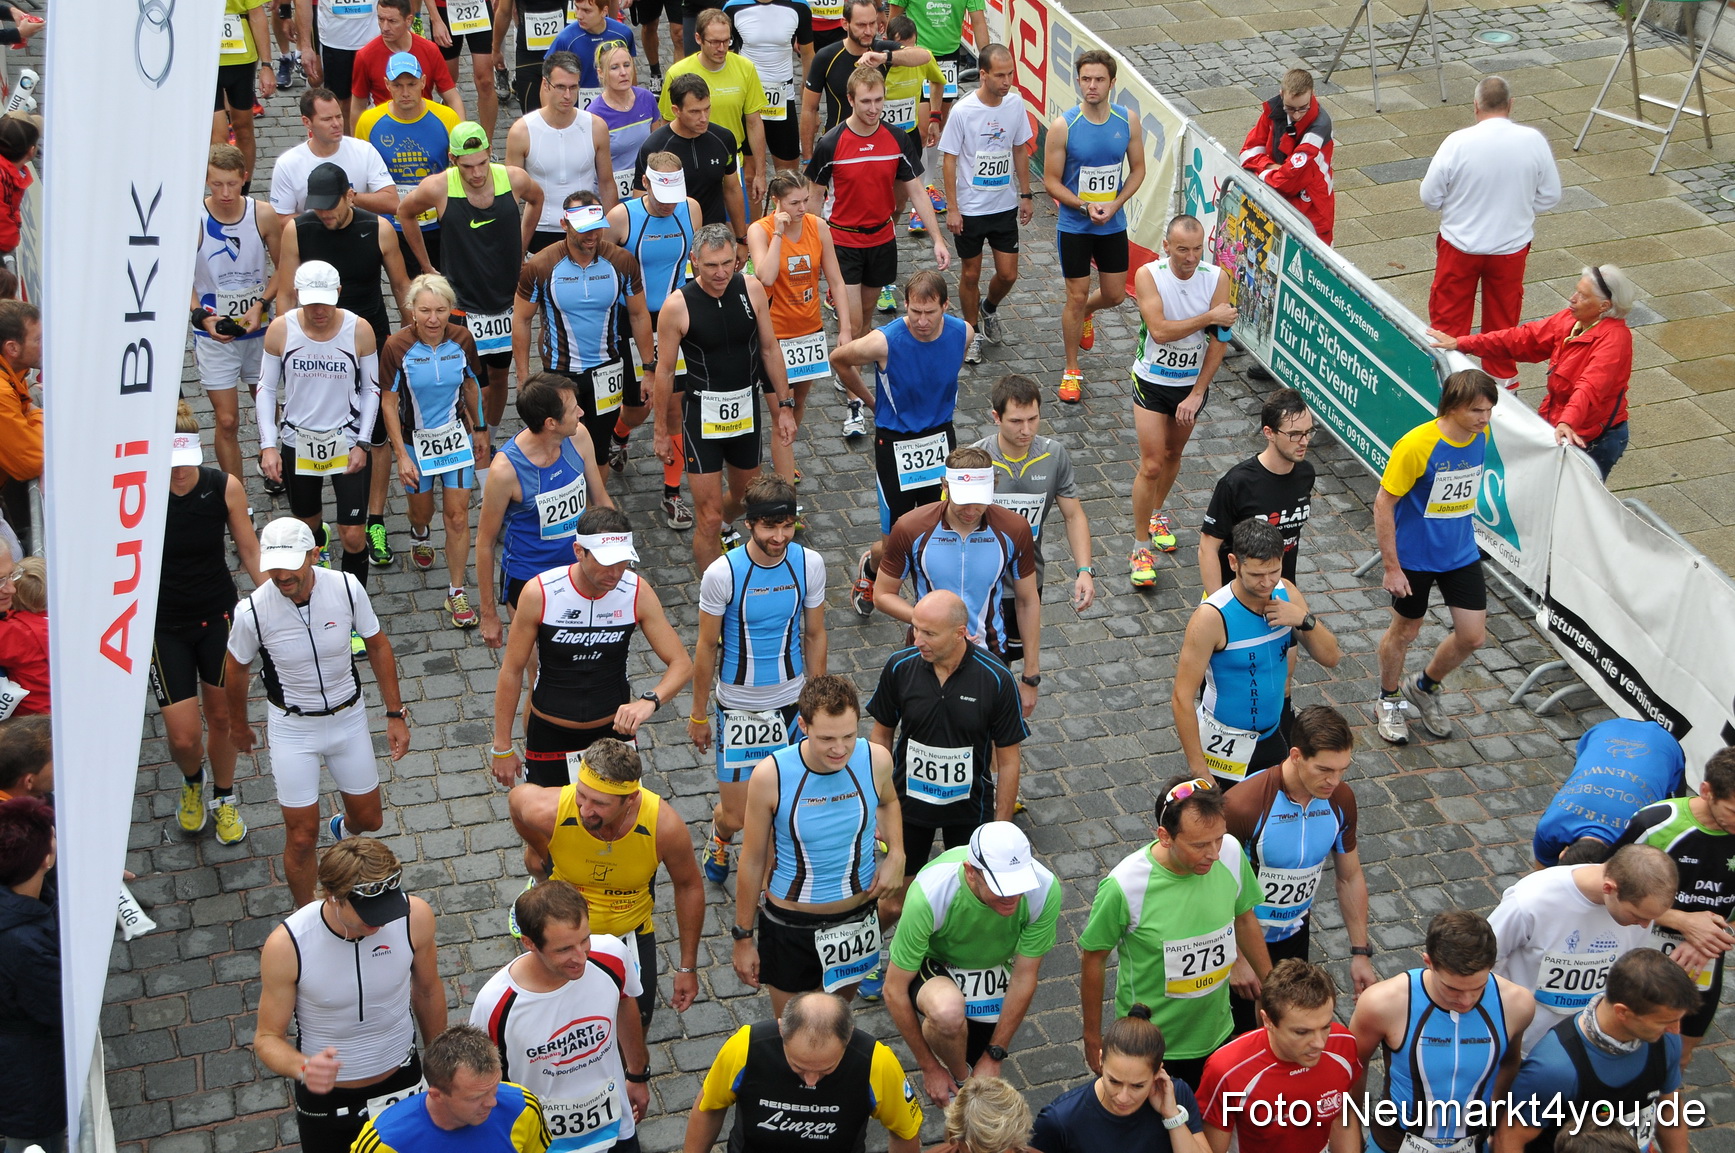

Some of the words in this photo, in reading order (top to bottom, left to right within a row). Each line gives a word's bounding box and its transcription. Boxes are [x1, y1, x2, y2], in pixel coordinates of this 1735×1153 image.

[456, 5, 480, 21] 232
[221, 23, 232, 38] 8
[462, 21, 478, 30] Franz
[534, 21, 558, 37] 622
[978, 159, 1009, 176] 2500
[983, 177, 1004, 186] Michael
[1088, 174, 1115, 192] 619
[120, 180, 163, 395] BKK
[236, 289, 258, 299] Neumarkt
[1307, 269, 1380, 343] Event-Leit-Systeme
[473, 316, 512, 338] 3400
[1282, 292, 1317, 331] Mehr
[1317, 323, 1379, 394] Sicherheit
[307, 353, 334, 361] TEAM
[786, 344, 824, 366] 3375
[1156, 348, 1198, 369] 2894
[1279, 320, 1297, 348] für
[1299, 334, 1318, 367] Ihr
[1318, 356, 1359, 403] Event!
[292, 358, 348, 374] ERDINGER
[794, 364, 815, 375] HAIKE
[1160, 368, 1189, 379] Berthold
[293, 372, 348, 381] ALKOHOLFREI
[703, 394, 721, 402] PARTL
[722, 393, 745, 402] Neumarkt
[719, 402, 739, 421] 68
[1276, 357, 1293, 380] Miet
[1293, 374, 1300, 388] &
[1301, 381, 1327, 418] Service
[1328, 405, 1346, 434] Line:
[1346, 425, 1371, 455] 09181
[1371, 447, 1391, 475] 635
[714, 422, 742, 432] Manfred
[306, 440, 338, 461] 187
[420, 432, 465, 458] 2642
[914, 439, 939, 450] Neumarkt
[313, 460, 334, 470] Klaus
[433, 454, 460, 468] Marion
[901, 445, 945, 471] 3324
[538, 494, 560, 506] PARTL
[559, 484, 580, 499] Neumarkt
[1441, 480, 1473, 501] 245
[546, 490, 585, 525] 2200
[1437, 503, 1469, 513] Johannes
[1473, 521, 1498, 549] Service
[1498, 545, 1521, 569] GmbH
[100, 440, 150, 676] Audi
[551, 629, 624, 647] Energizer
[1600, 657, 1618, 679] die
[1620, 673, 1673, 732] verbinden
[730, 721, 783, 746] 2028
[744, 748, 769, 759] Armin
[908, 745, 927, 757] PARTL
[928, 750, 961, 760] Neumarkt
[1206, 734, 1237, 758] 24
[912, 756, 967, 783] 2618
[1203, 755, 1233, 772] atthias
[922, 783, 954, 797] Herbert
[1260, 871, 1286, 881] PARTL
[1286, 870, 1317, 881] Neumarkt
[1265, 877, 1317, 905] 2283
[1695, 880, 1722, 893] DAV
[816, 930, 839, 943] PARTL
[1165, 943, 1192, 955] PARTL
[1192, 933, 1227, 950] Neumarkt
[372, 949, 392, 958] skinfit
[822, 929, 876, 966] 2042
[1181, 944, 1226, 978] 273
[1544, 955, 1572, 966] PARTL
[1573, 957, 1608, 967] Neumarkt
[833, 961, 869, 980] Thomas
[1546, 966, 1609, 990] 2005
[956, 970, 1009, 998] 2704
[1195, 976, 1214, 989] Udo
[965, 1002, 1000, 1015] Thomas
[1553, 995, 1590, 1007] Thomas
[526, 1024, 595, 1057] GERHART
[529, 1051, 561, 1064] Autohaus
[542, 1068, 555, 1077] Das
[555, 1062, 587, 1077] sportliche
[543, 1103, 572, 1111] PARTL
[572, 1089, 607, 1109] Neumarkt
[759, 1098, 840, 1113] REISEBÜRO
[550, 1096, 615, 1137] 3351
[757, 1110, 838, 1139] Linzer
